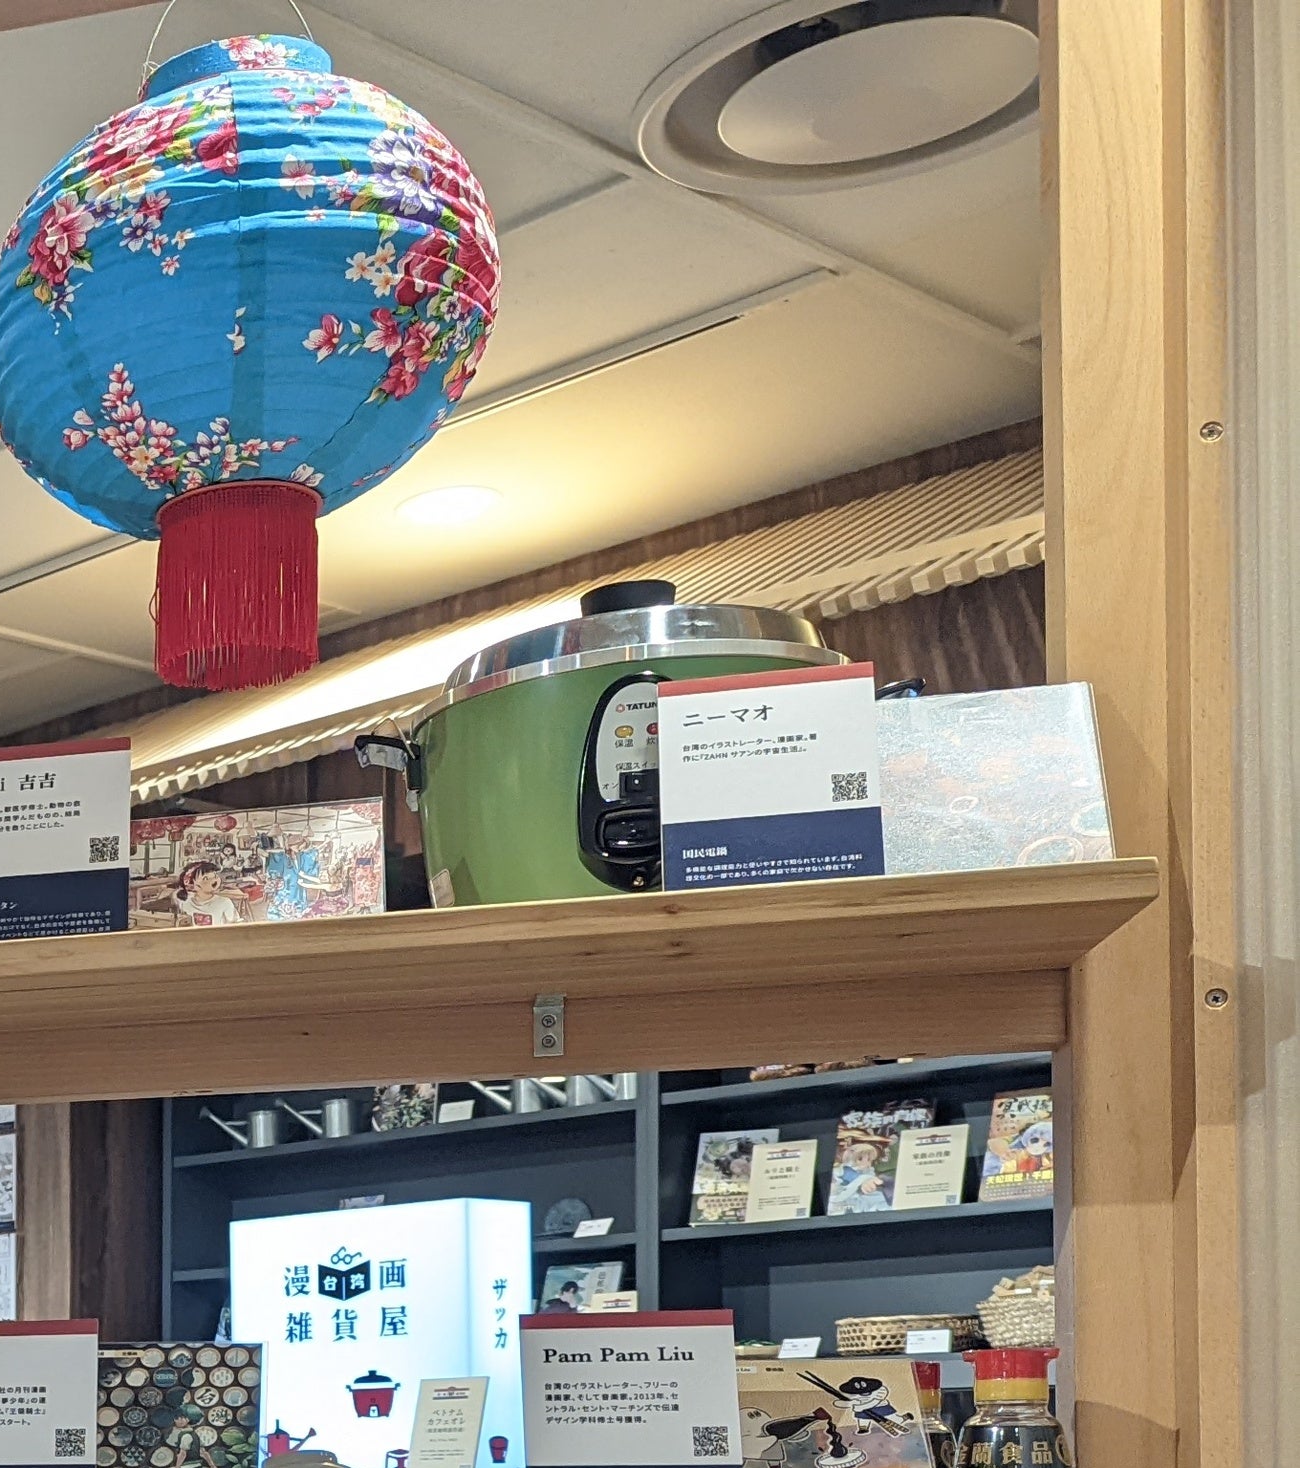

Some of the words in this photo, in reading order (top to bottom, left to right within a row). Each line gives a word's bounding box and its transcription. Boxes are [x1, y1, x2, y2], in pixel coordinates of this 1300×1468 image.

[625, 701, 658, 711] TATUN
[682, 704, 774, 728] ニーマオ
[615, 760, 657, 772] 保温スイッ
[18, 772, 56, 791] 吉吉
[491, 1276, 509, 1350] ザッカ
[284, 1305, 409, 1344] 雑貨屋
[543, 1348, 593, 1364] Pam
[600, 1347, 650, 1363] Pam
[657, 1346, 695, 1362] Liu
